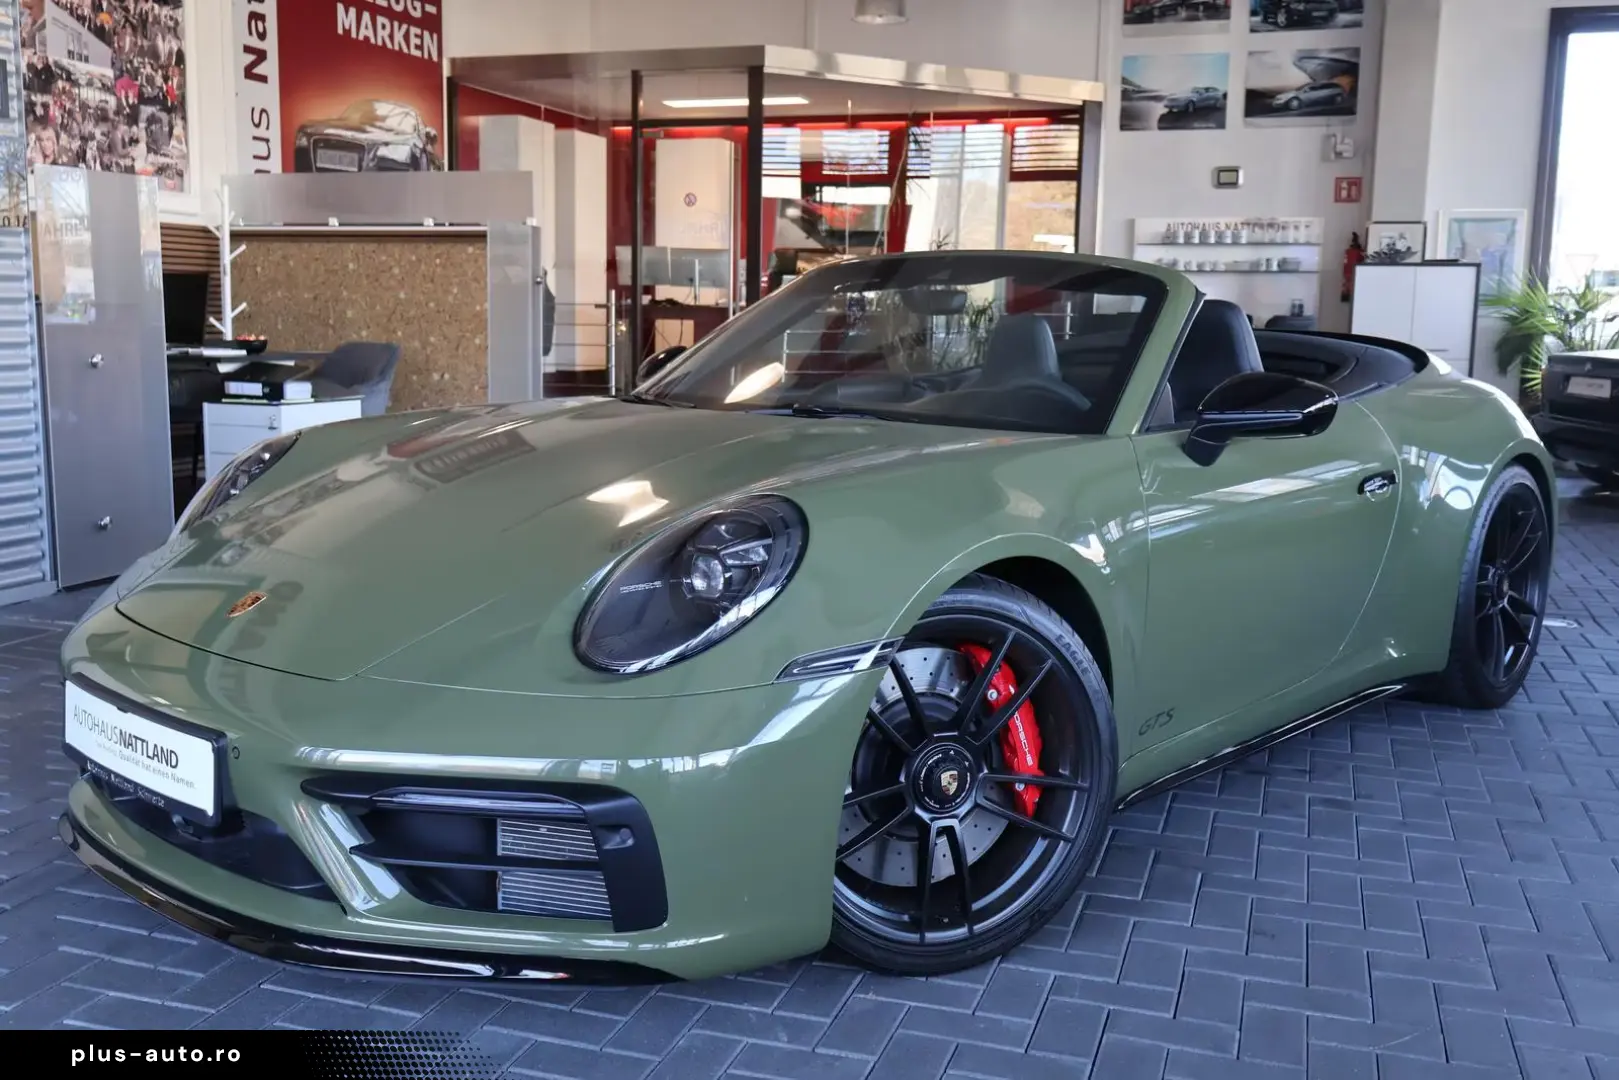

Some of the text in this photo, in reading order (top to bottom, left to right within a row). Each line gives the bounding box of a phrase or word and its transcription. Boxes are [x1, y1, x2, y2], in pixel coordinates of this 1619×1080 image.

[335, 1, 438, 63] MARKEN
[243, 0, 272, 174] us Na
[1055, 634, 1092, 676] EAGLE
[1014, 711, 1034, 767] ORSCHE
[1138, 707, 1176, 737] GTS
